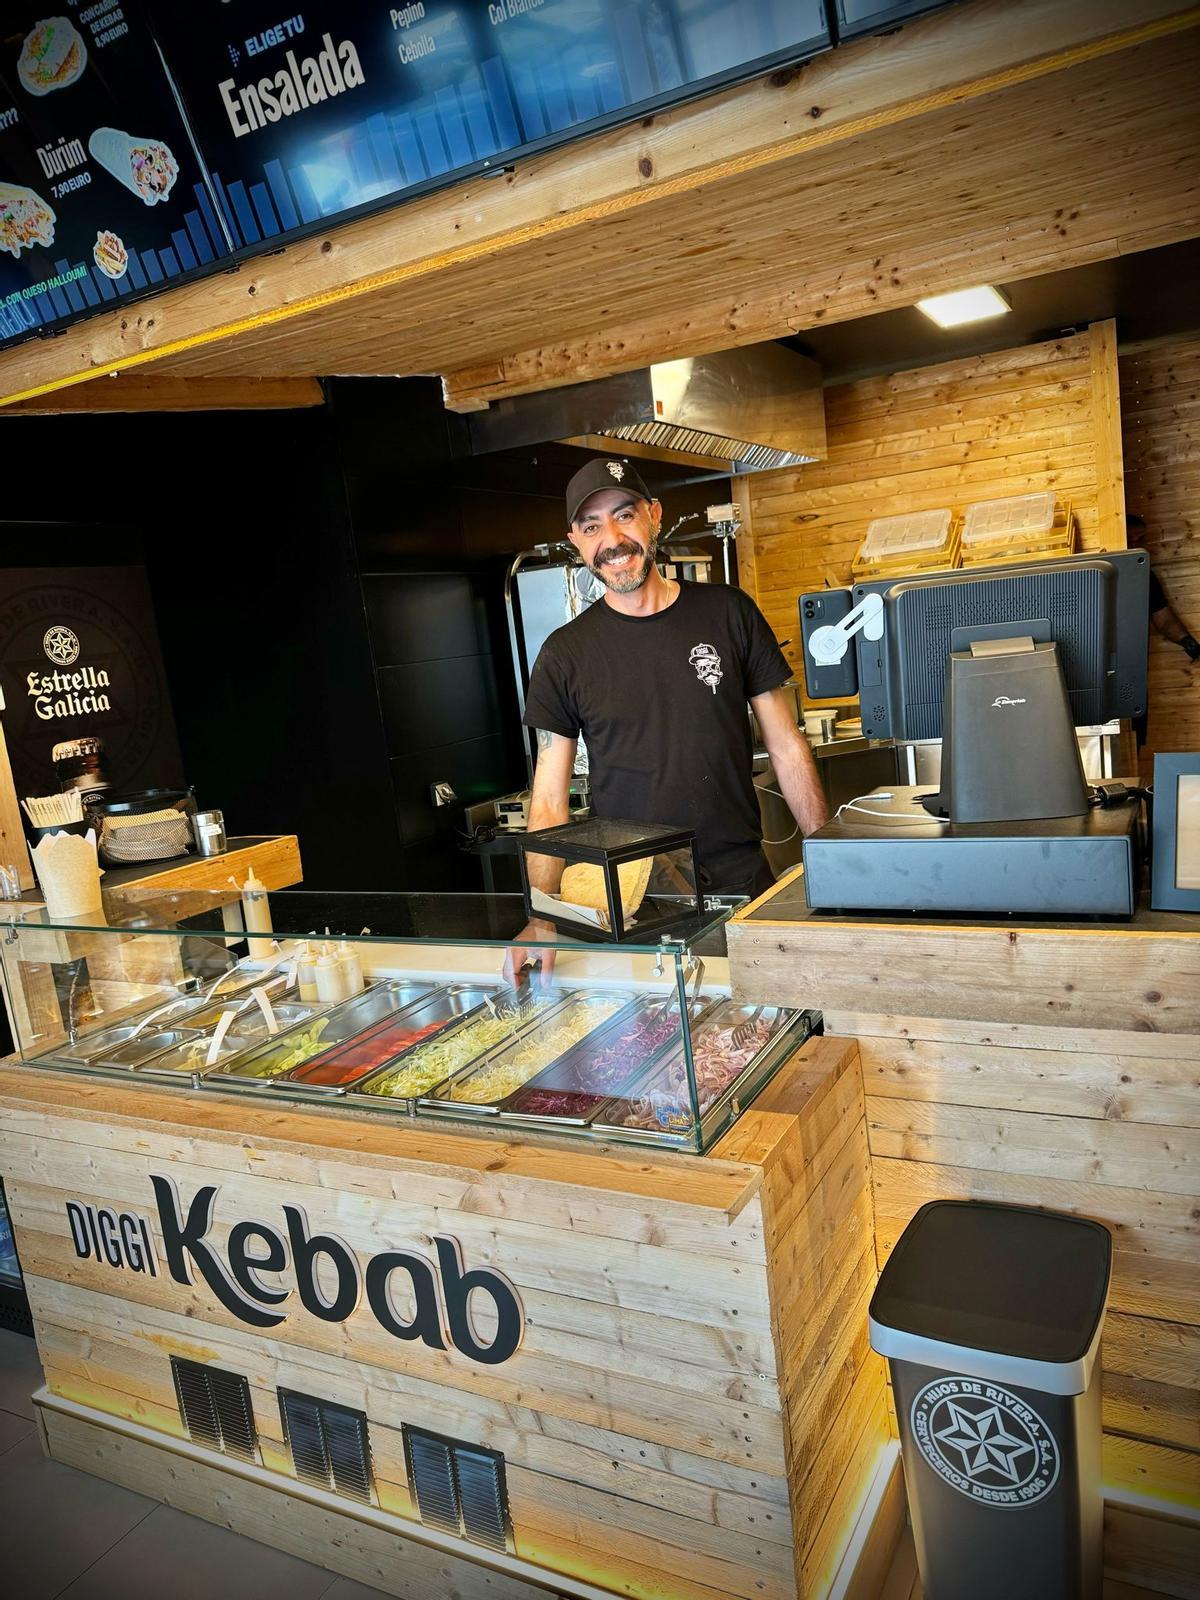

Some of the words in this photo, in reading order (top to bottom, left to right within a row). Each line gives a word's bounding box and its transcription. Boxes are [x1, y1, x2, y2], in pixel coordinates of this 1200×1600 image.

[390, 2, 425, 30] Pepino
[488, 0, 507, 25] Col
[398, 34, 436, 64] Cebolla
[218, 32, 365, 138] Ensalada
[36, 136, 88, 180] Dürüm
[69, 172, 92, 191] EURO
[6, 291, 21, 306] CON
[22, 281, 48, 300] QUESO
[47, 265, 88, 290] HALLOUMI
[26, 666, 111, 697] Estrella
[34, 689, 112, 721] Galicia
[65, 1201, 157, 1277] DIGGI
[149, 1174, 525, 1365] Kebab
[926, 1382, 959, 1404] HIJOS
[961, 1381, 982, 1394] DE
[985, 1387, 1041, 1436] RIVERA,
[914, 1410, 970, 1490] CERVECEROS
[972, 1486, 1020, 1503] DESDE
[1019, 1476, 1047, 1501] 1906
